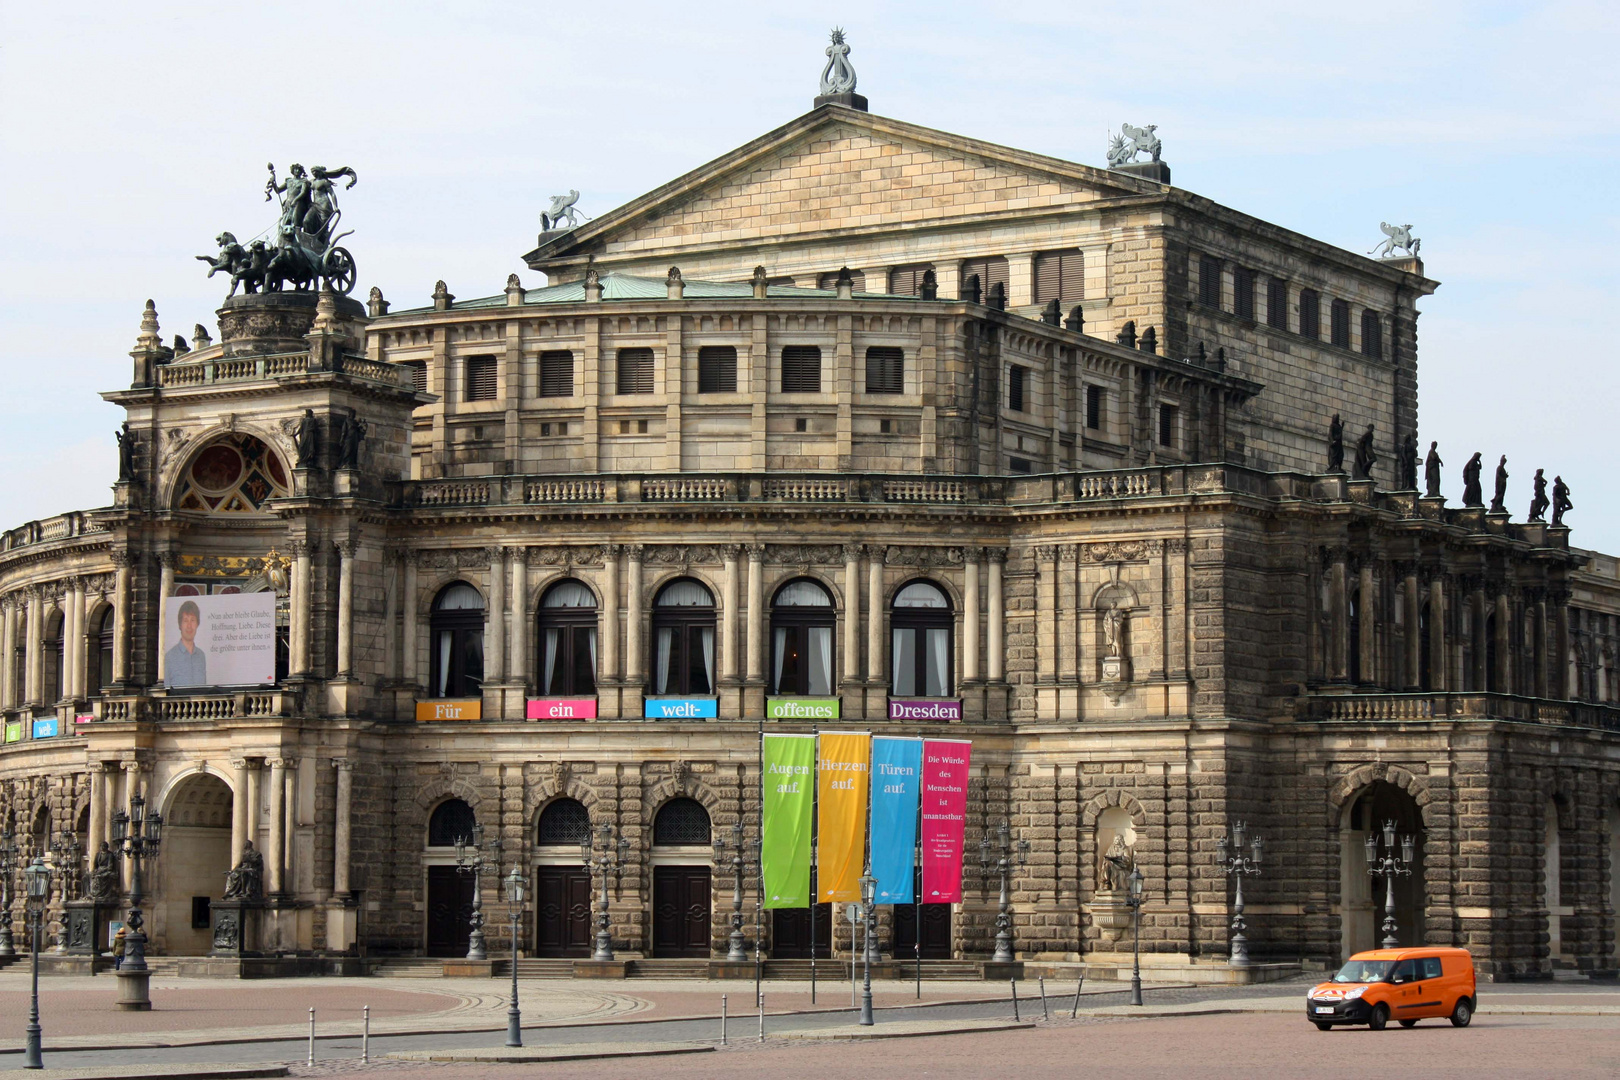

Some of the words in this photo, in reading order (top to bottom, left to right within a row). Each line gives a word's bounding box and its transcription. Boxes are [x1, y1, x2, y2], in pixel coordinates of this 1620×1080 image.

[223, 612, 234, 620] aber
[234, 611, 250, 619] bleibt
[251, 610, 271, 618] Glaube,
[212, 622, 237, 631] Hoffnung,
[256, 621, 270, 629] Diese
[220, 644, 236, 653] größte
[434, 704, 462, 719] Für
[549, 704, 574, 717] ein
[661, 702, 700, 716] welt-
[774, 702, 832, 718] offenes
[891, 703, 958, 719] Dresden
[820, 759, 867, 772] Herzen
[928, 756, 940, 764] Die
[942, 756, 964, 764] Würde
[768, 762, 810, 777] Augen
[878, 763, 914, 776] Türen
[776, 782, 800, 793] auf.
[831, 778, 854, 790] auf.
[884, 782, 906, 794] auf.
[926, 784, 962, 792] Menschen
